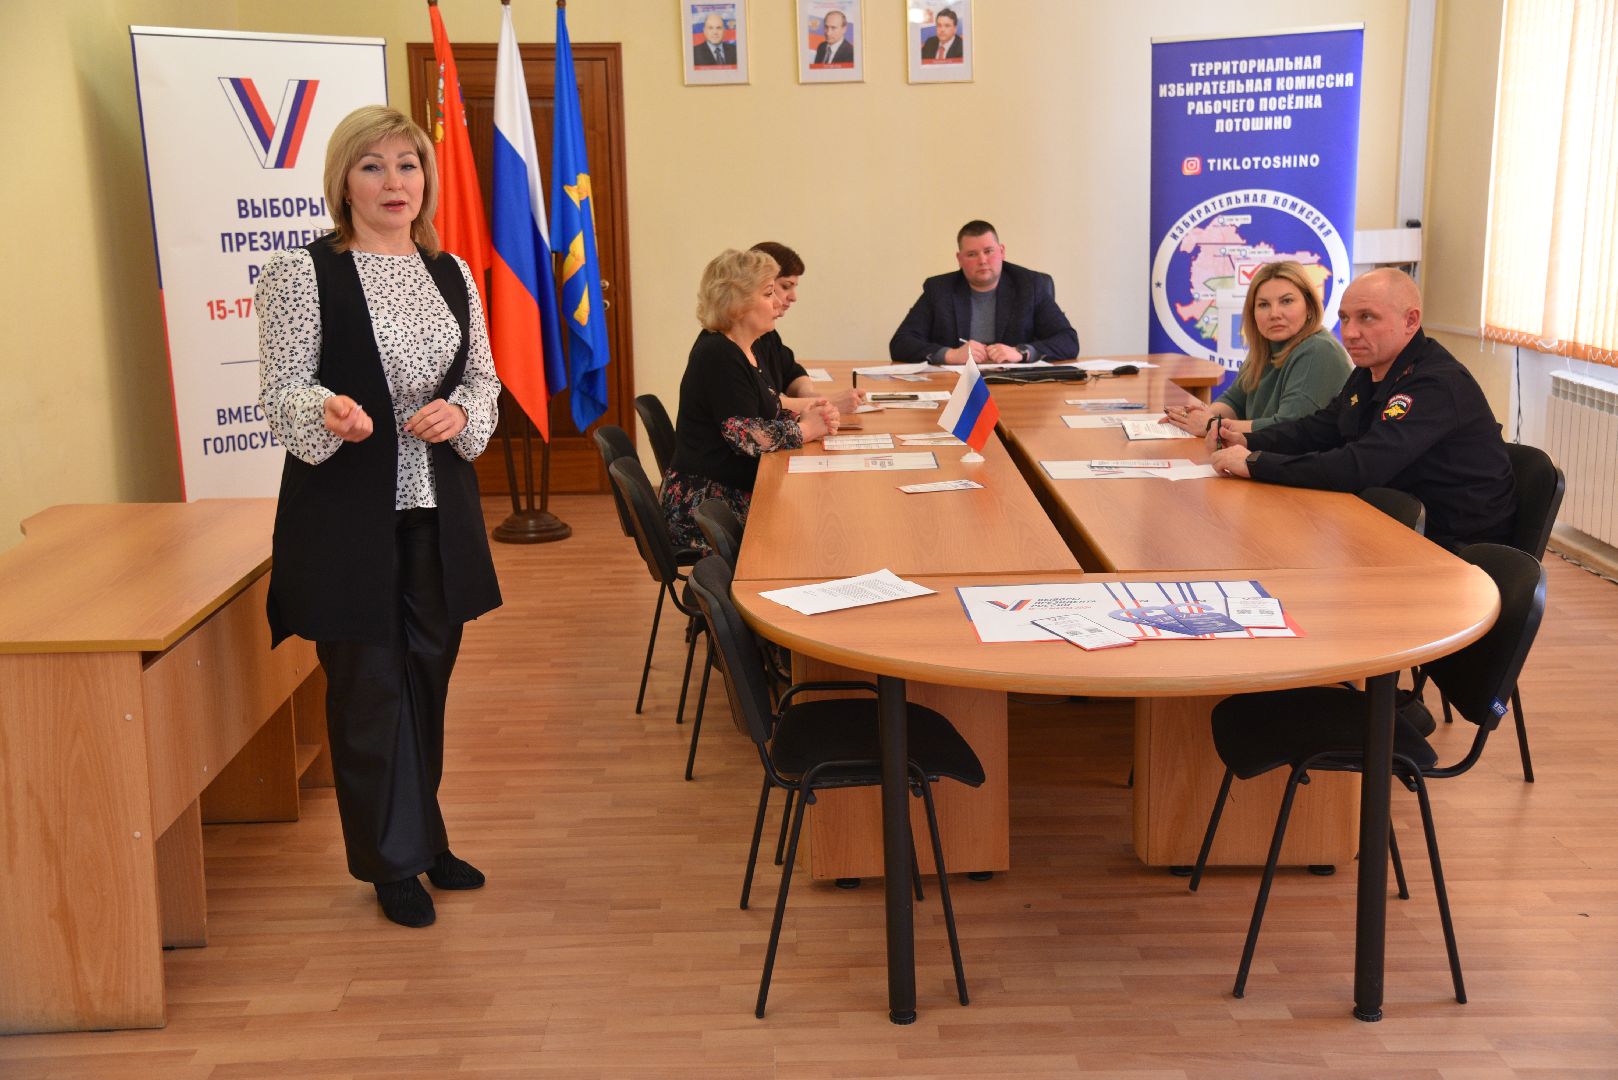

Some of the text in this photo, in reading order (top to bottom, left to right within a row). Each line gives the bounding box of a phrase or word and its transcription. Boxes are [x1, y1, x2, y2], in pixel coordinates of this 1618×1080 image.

[1190, 55, 1322, 77] ТЕРРИТОРИАЛЬНАЯ
[1159, 72, 1354, 98] ИЗБИРАТЕЛЬНАЯ КОМИССИЯ
[1187, 93, 1323, 115] РАБОЧЕГО ПОСЁЛКА
[1215, 115, 1292, 133] ЛОТОШИНО
[1207, 154, 1320, 172] TIKLOTOSHINO
[237, 197, 326, 219] ВЫБОРЫ
[1170, 193, 1333, 241] ИЗБИРАТЕЛЬНАЯ КОМИССИЯ
[206, 297, 252, 320] 15-17
[216, 404, 265, 425] ВМЕС
[202, 430, 280, 456] ГОЛОСУЕ
